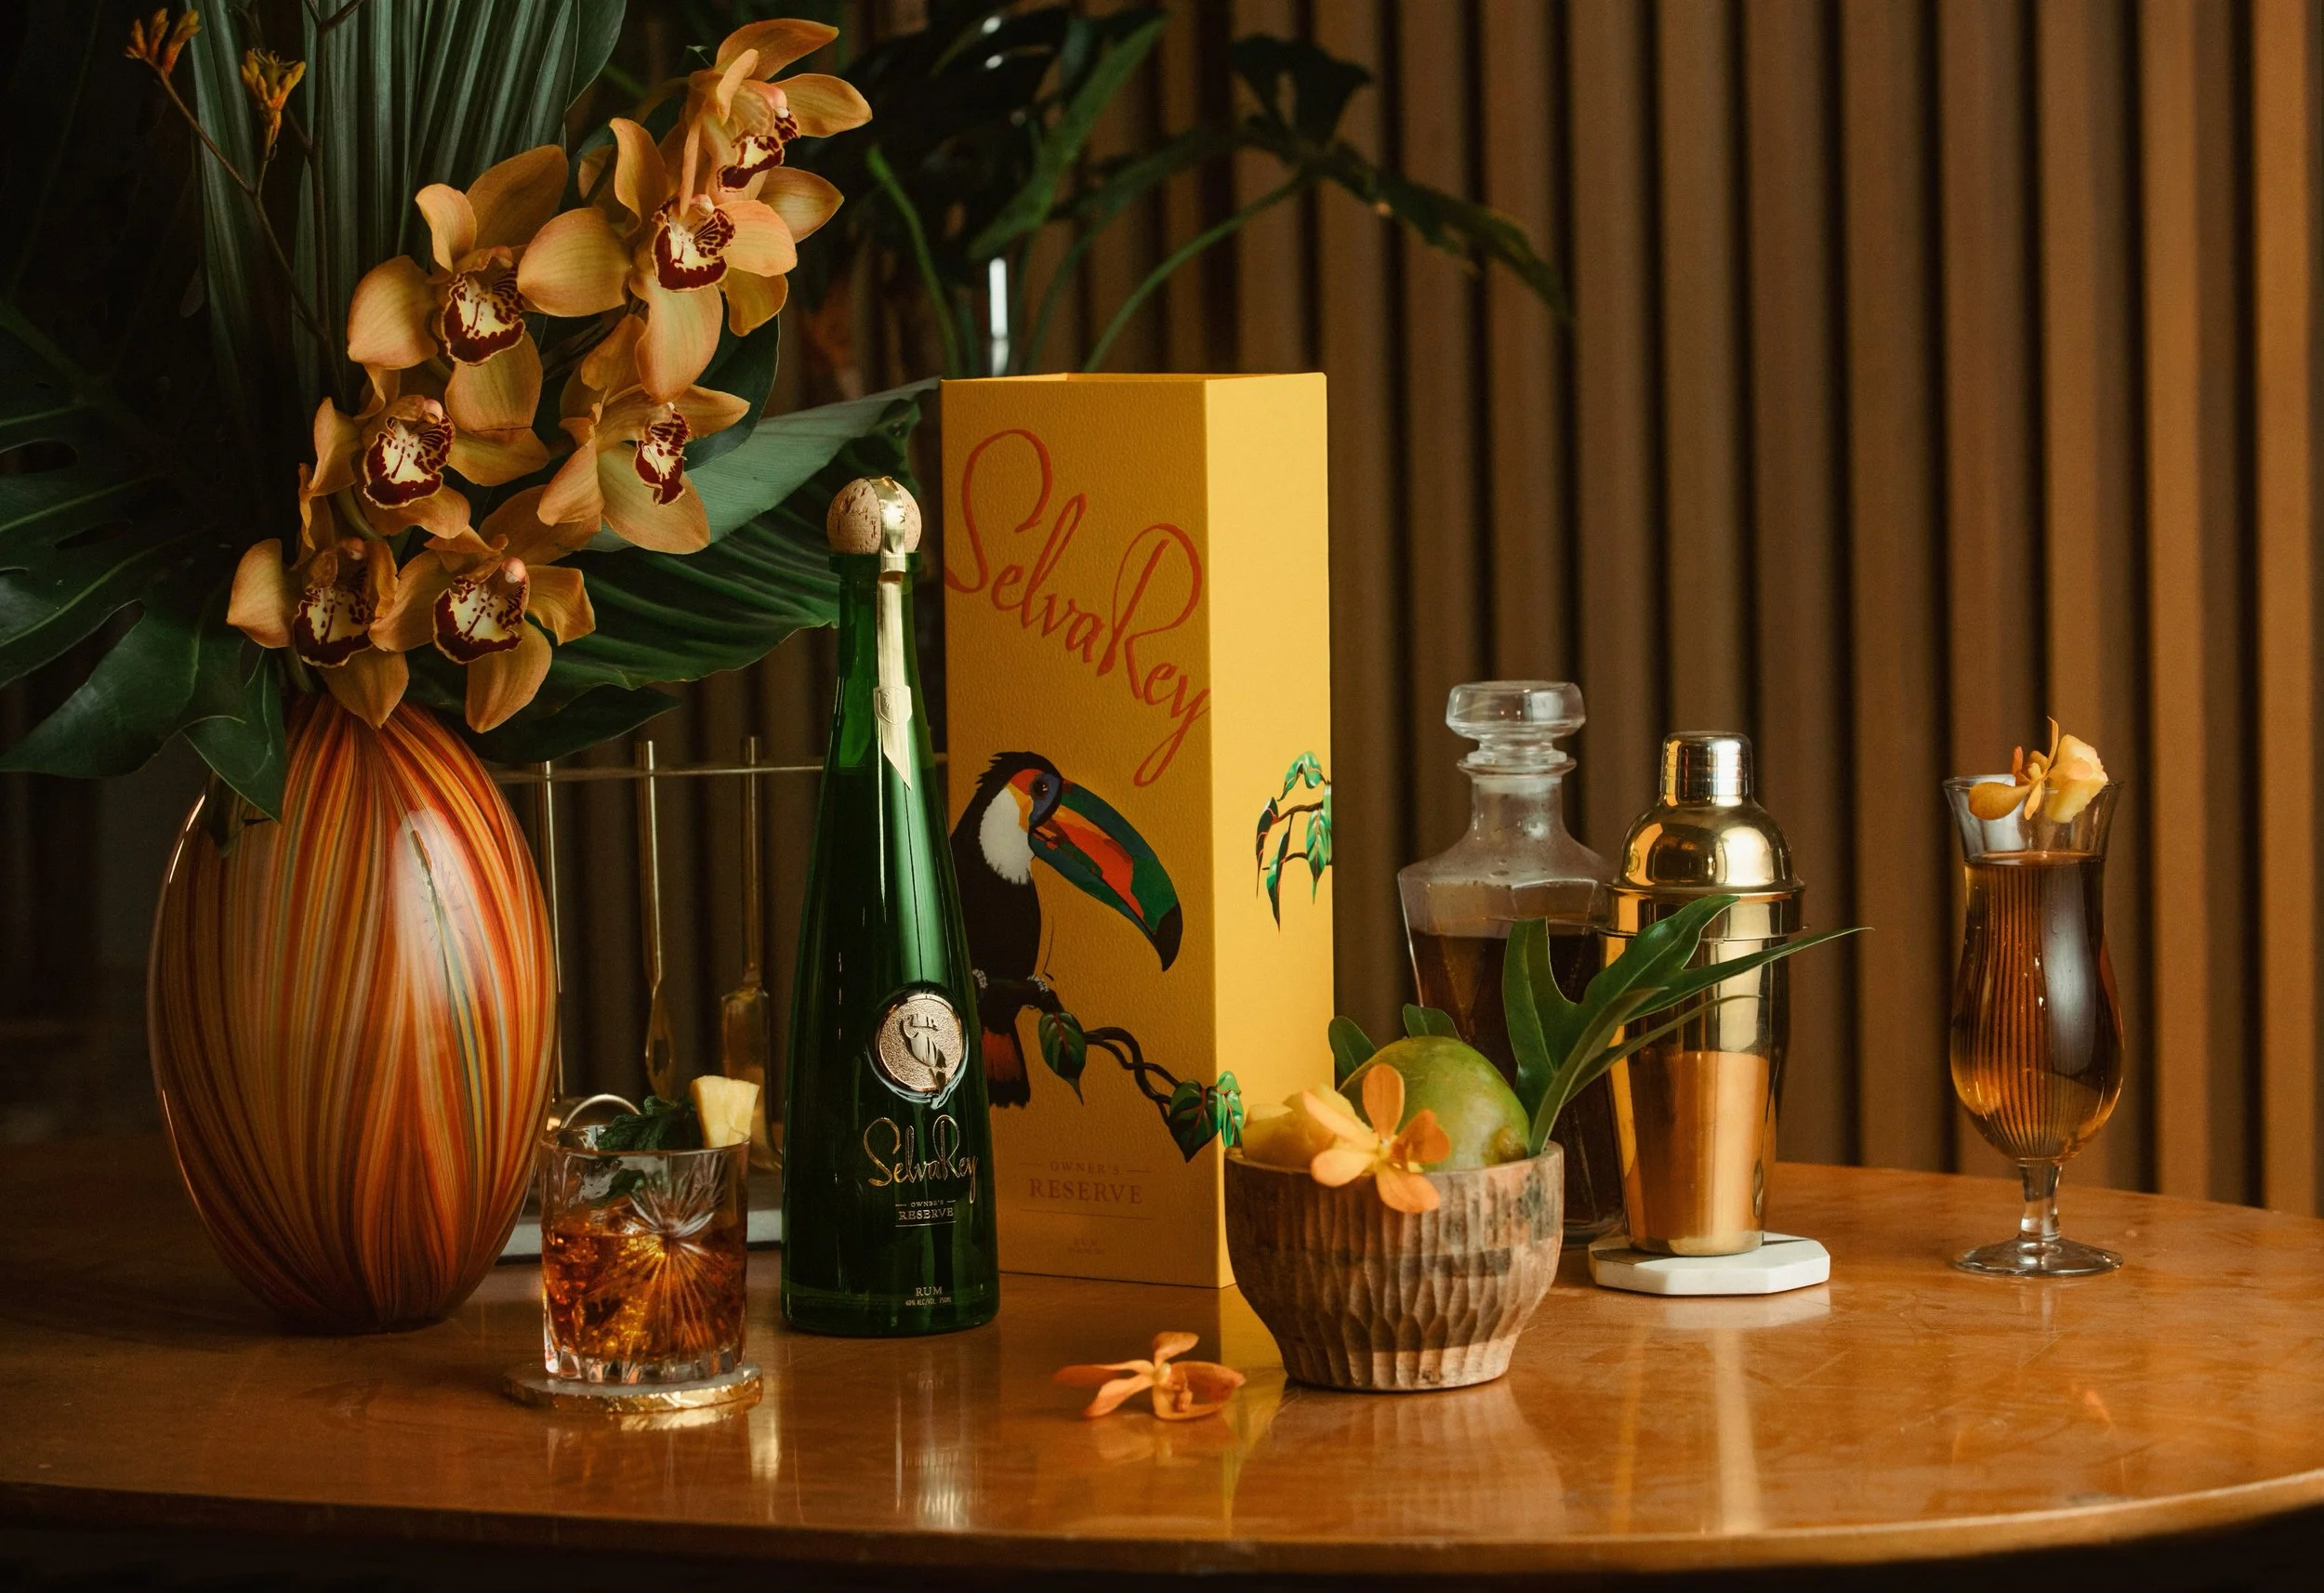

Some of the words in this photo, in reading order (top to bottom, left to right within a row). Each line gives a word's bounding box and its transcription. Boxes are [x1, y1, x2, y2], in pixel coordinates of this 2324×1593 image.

[944, 428, 1210, 787] SelvaRey
[864, 1114, 978, 1204] SelvaRey
[1050, 1162, 1120, 1175] OWNER'S
[1029, 1178, 1142, 1205] RESERVE
[898, 1207, 954, 1220] RESERVE
[916, 1286, 943, 1297] RUM
